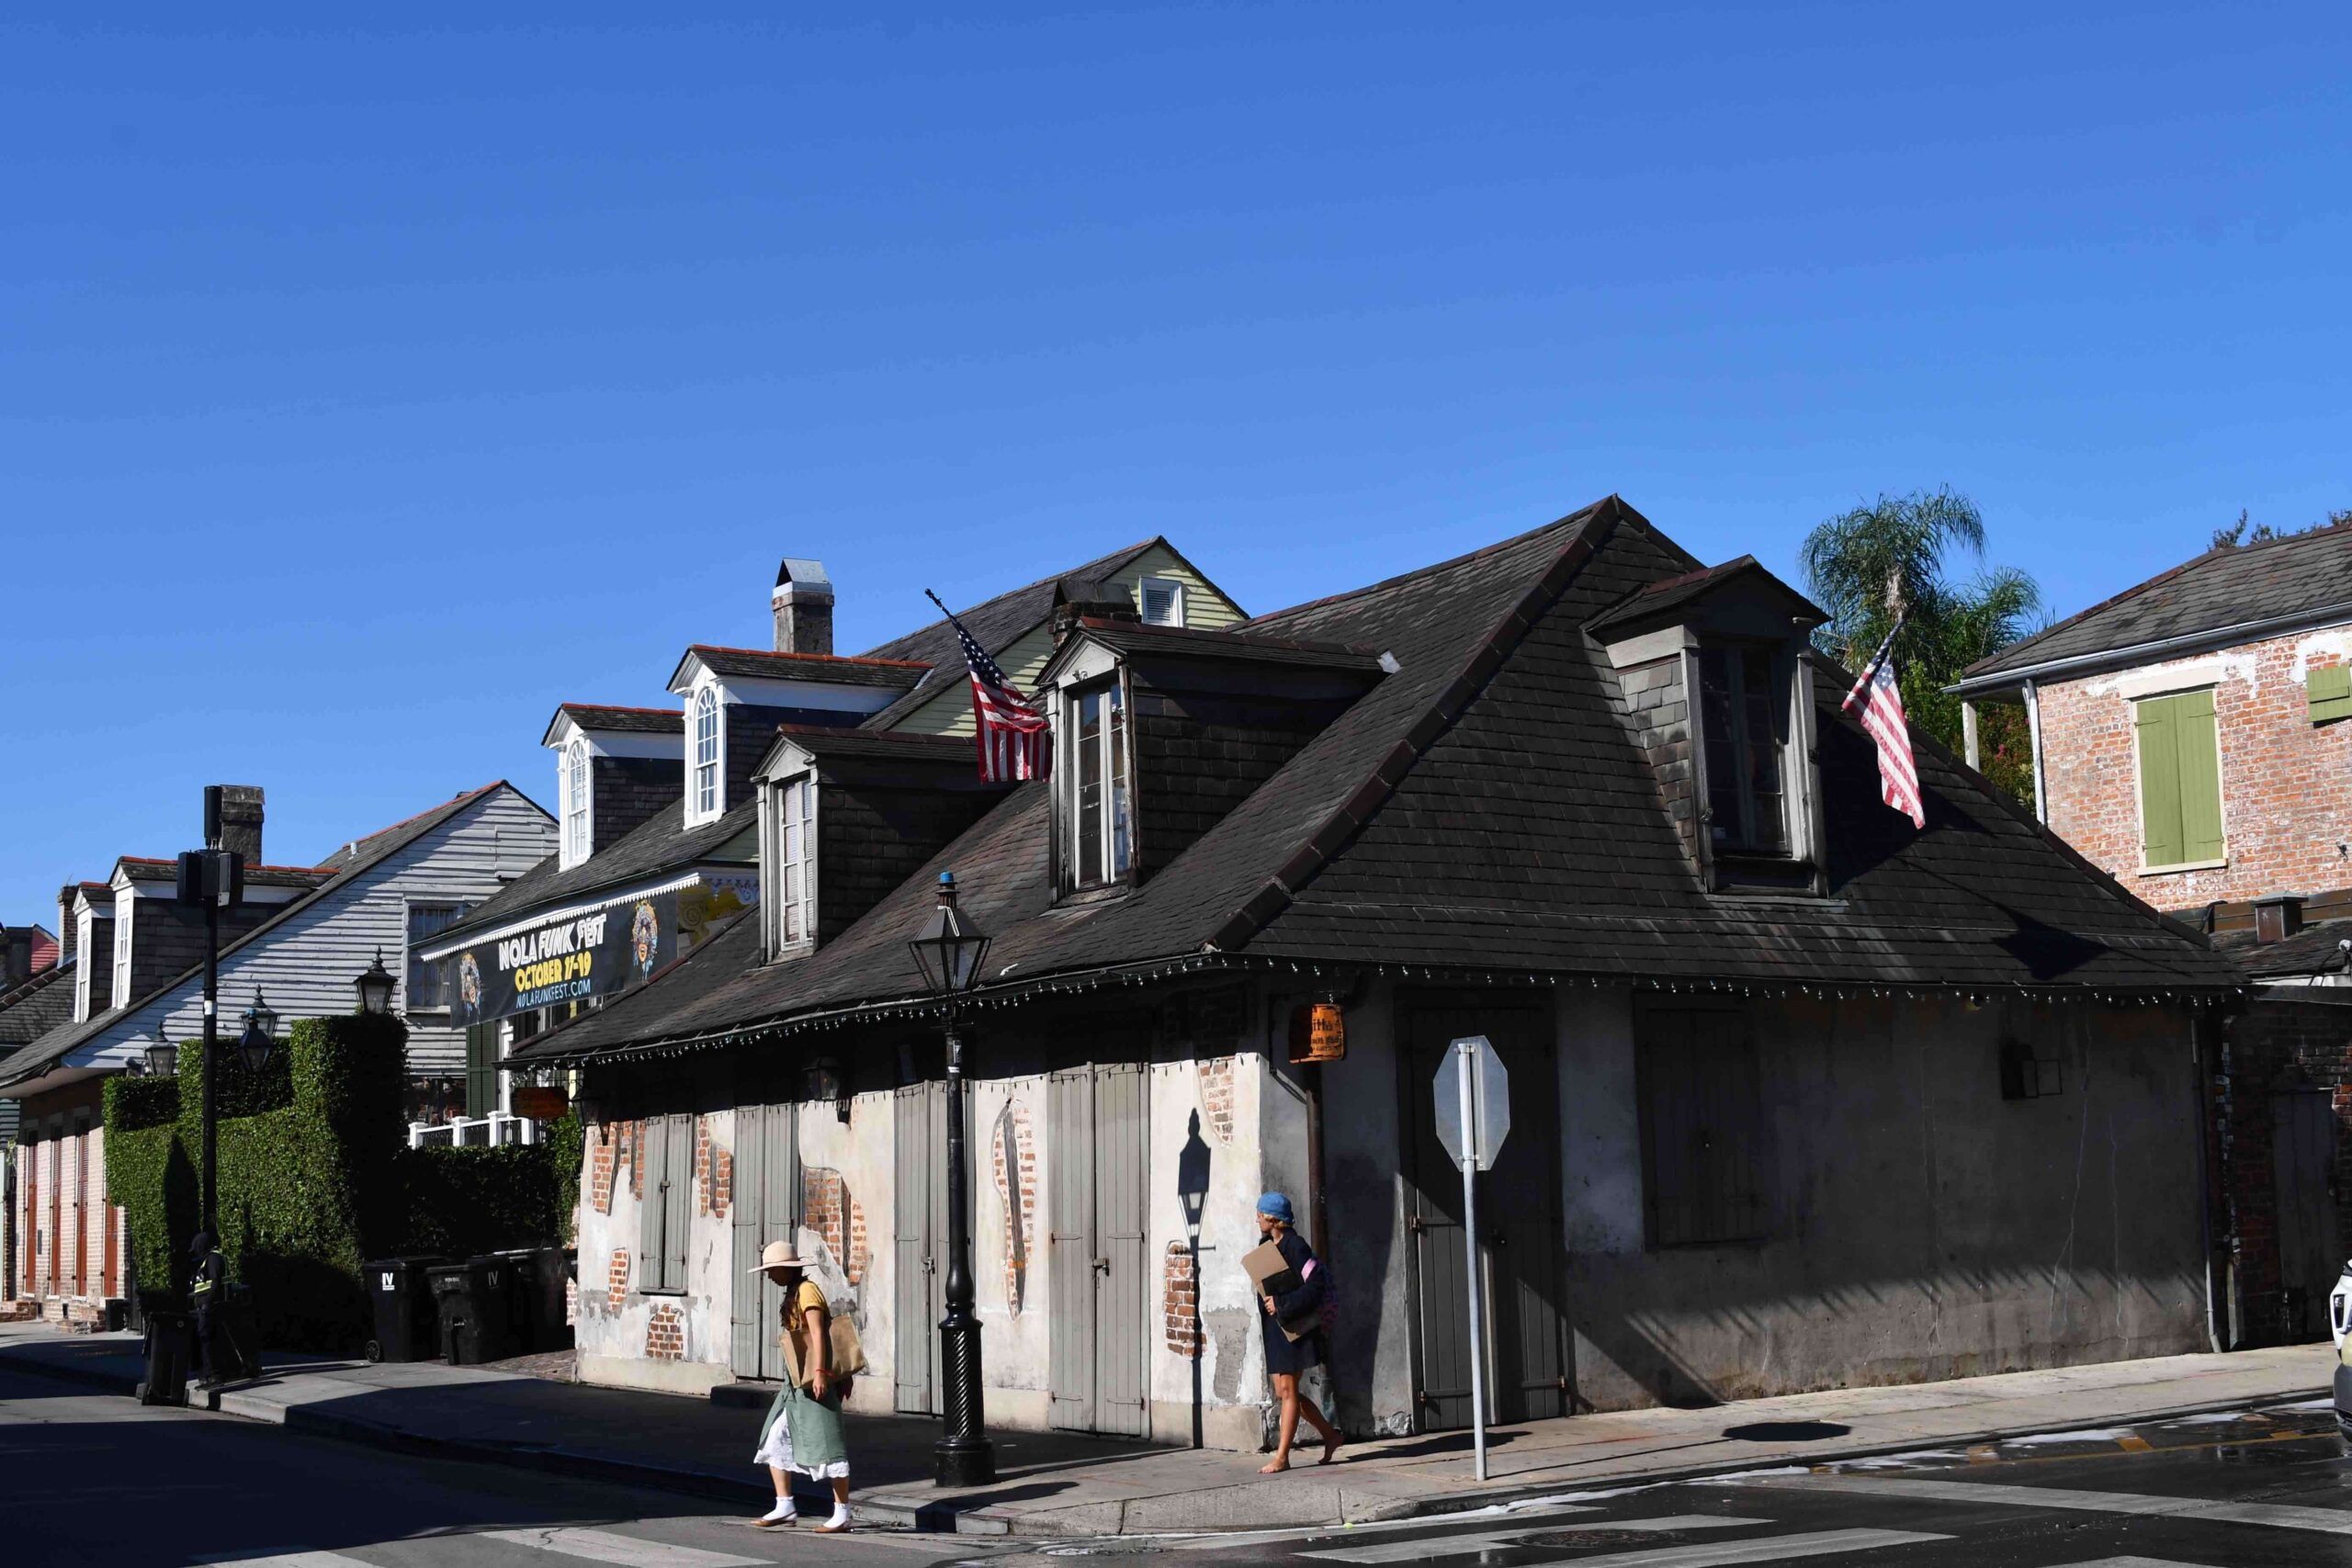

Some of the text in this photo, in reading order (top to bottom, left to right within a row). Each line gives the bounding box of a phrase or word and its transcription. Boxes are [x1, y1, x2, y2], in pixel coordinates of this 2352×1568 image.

[499, 913, 606, 971] NOLA FUNK FEST
[514, 951, 592, 992] OCTOBER 17-19
[515, 978, 591, 1009] NOLAFUNKFEST.COM
[381, 1272, 394, 1285] IV
